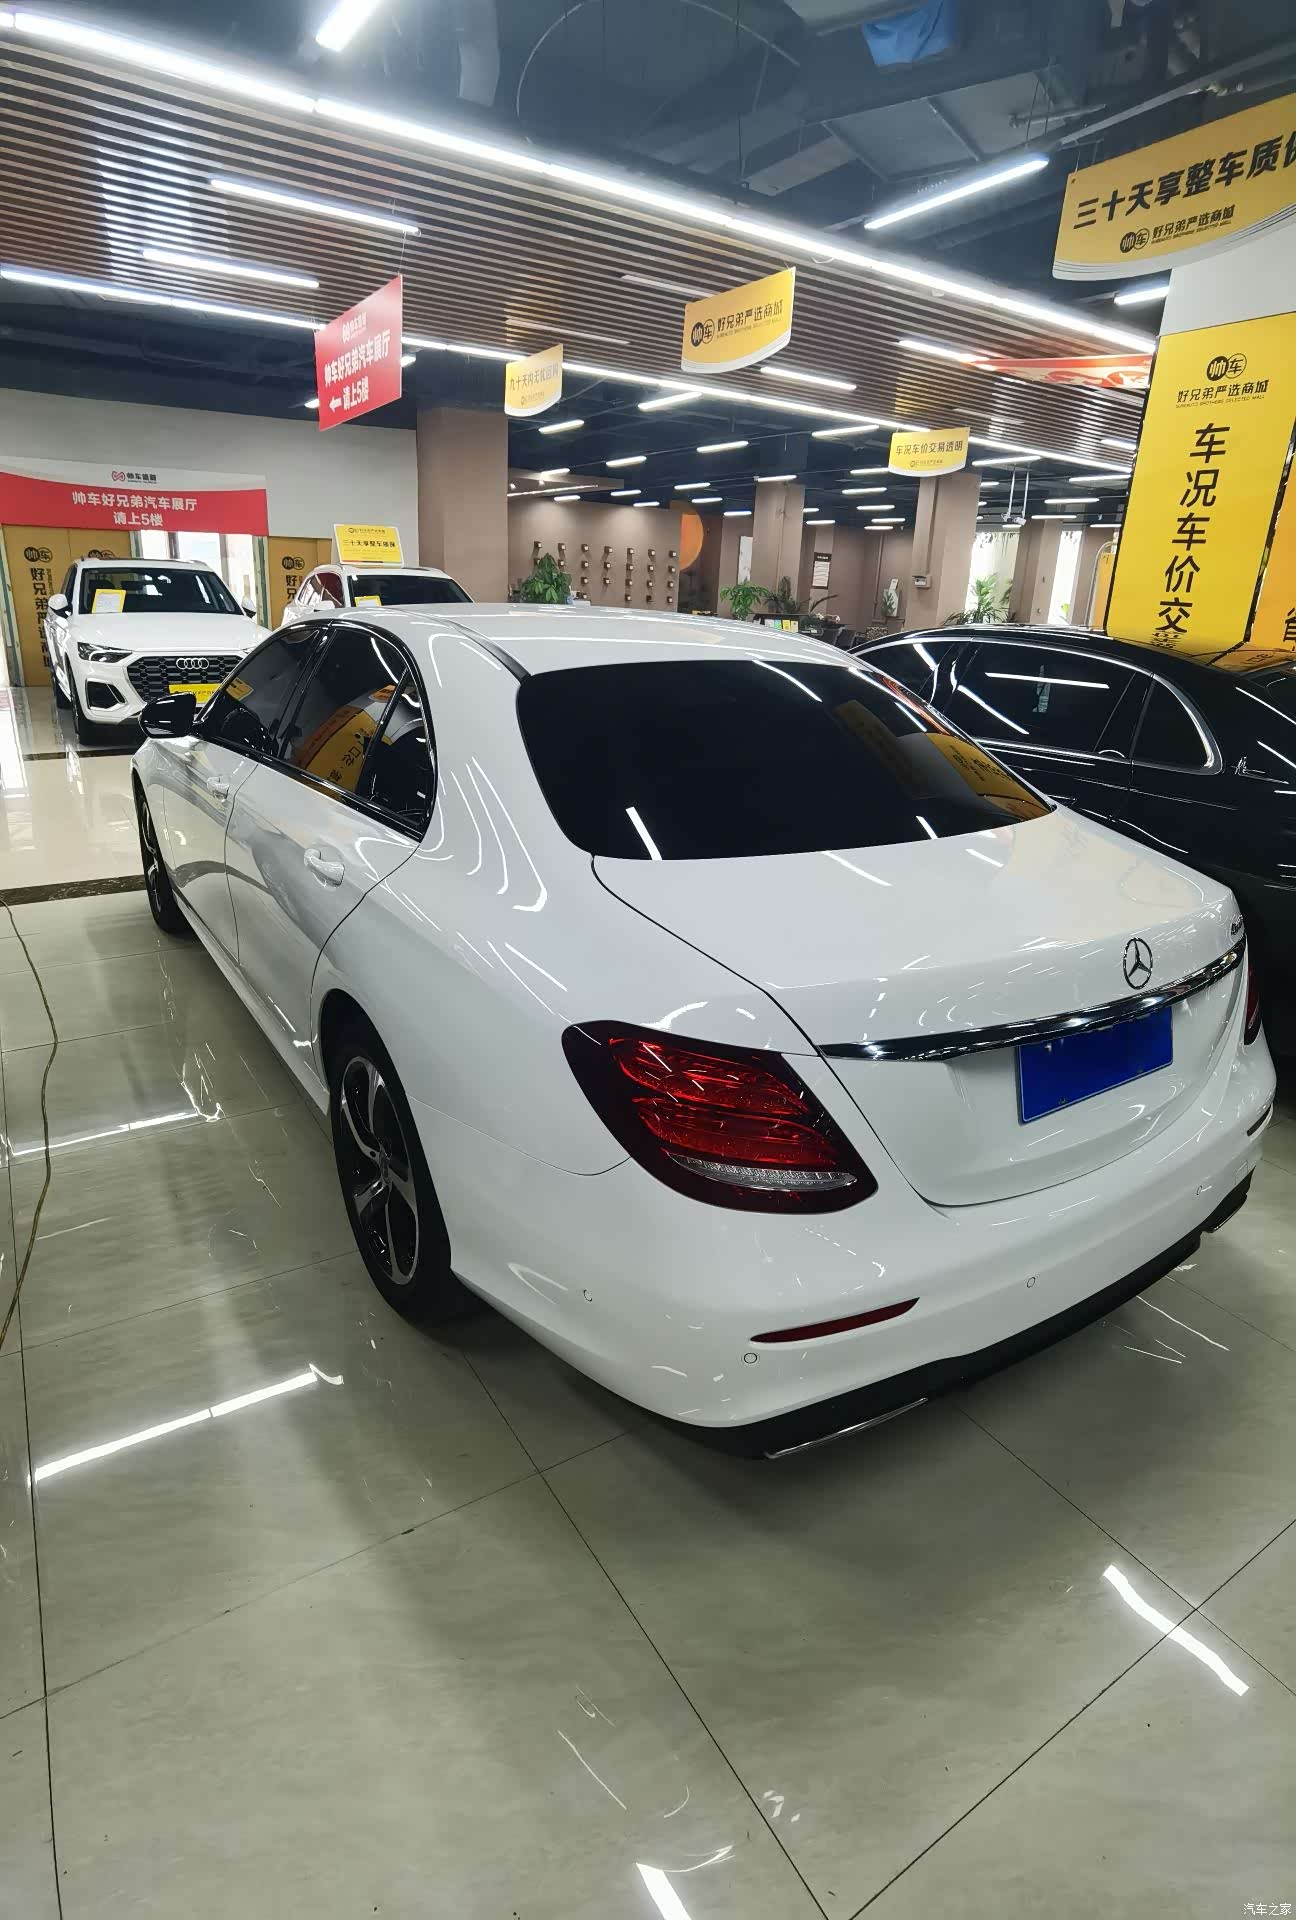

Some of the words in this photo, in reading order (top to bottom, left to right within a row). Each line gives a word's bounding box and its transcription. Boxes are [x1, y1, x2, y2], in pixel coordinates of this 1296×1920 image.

[1151, 204, 1236, 239] 好兄弟严选商城
[717, 299, 783, 333] 好兄弟严选商城
[324, 328, 391, 388] 帅车好兄弟汽车展厅
[1206, 353, 1247, 381] 帅车
[342, 375, 369, 411] 请上5楼
[1176, 380, 1270, 404] 好兄弟严选商城
[895, 440, 963, 456] 车况车价交易透明
[71, 491, 198, 512] 帅车好兄弟汽车展厅
[113, 511, 164, 527] 请上5楼
